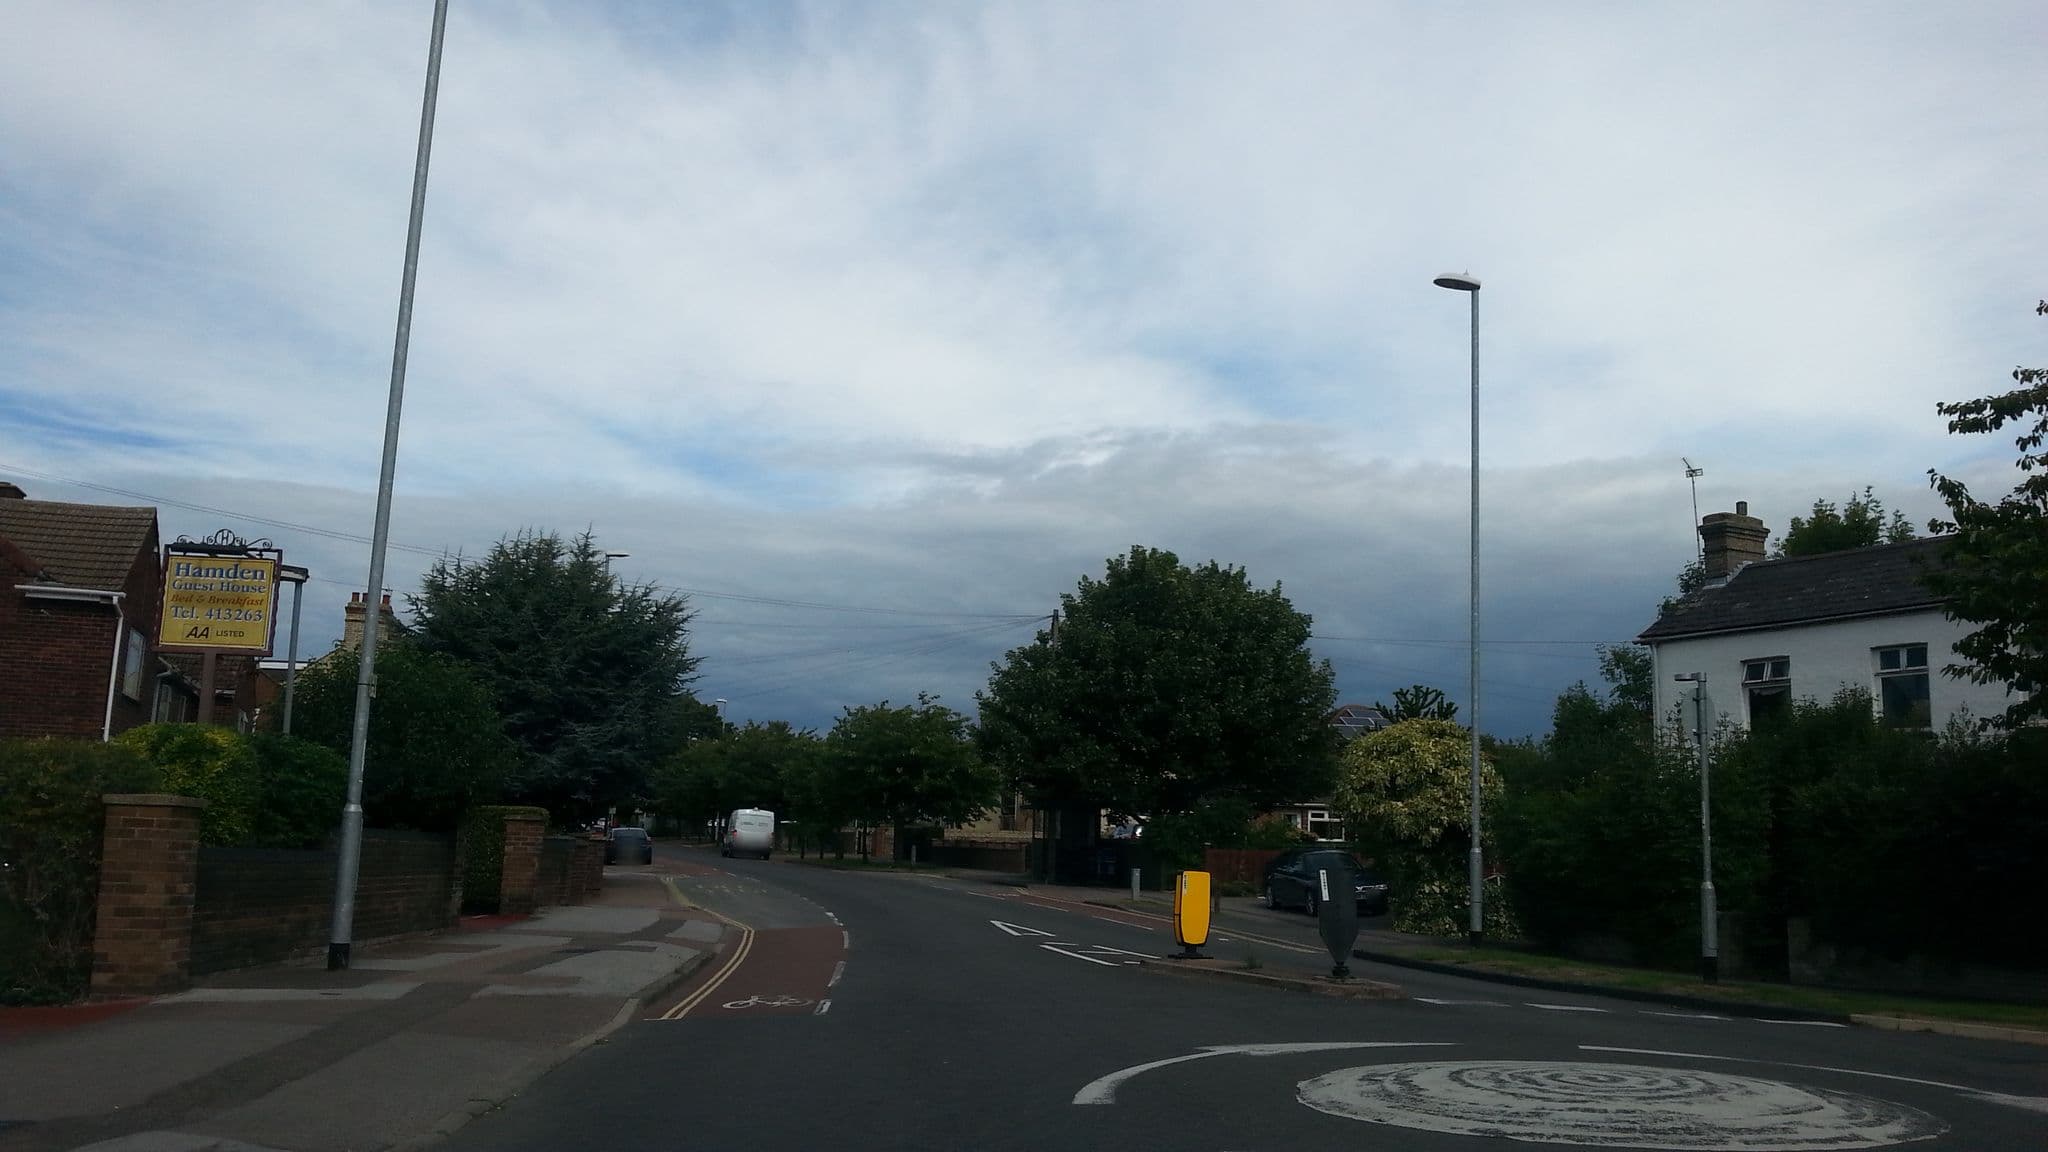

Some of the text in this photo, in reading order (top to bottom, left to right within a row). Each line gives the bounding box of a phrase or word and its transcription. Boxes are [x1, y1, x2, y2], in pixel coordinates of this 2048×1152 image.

[175, 562, 265, 580] Hamden
[172, 579, 266, 593] Guest House
[170, 594, 194, 603] Bed
[208, 595, 265, 607] Breakfast
[170, 606, 263, 621] Tel. 413263
[186, 626, 244, 639] AA LISTED
